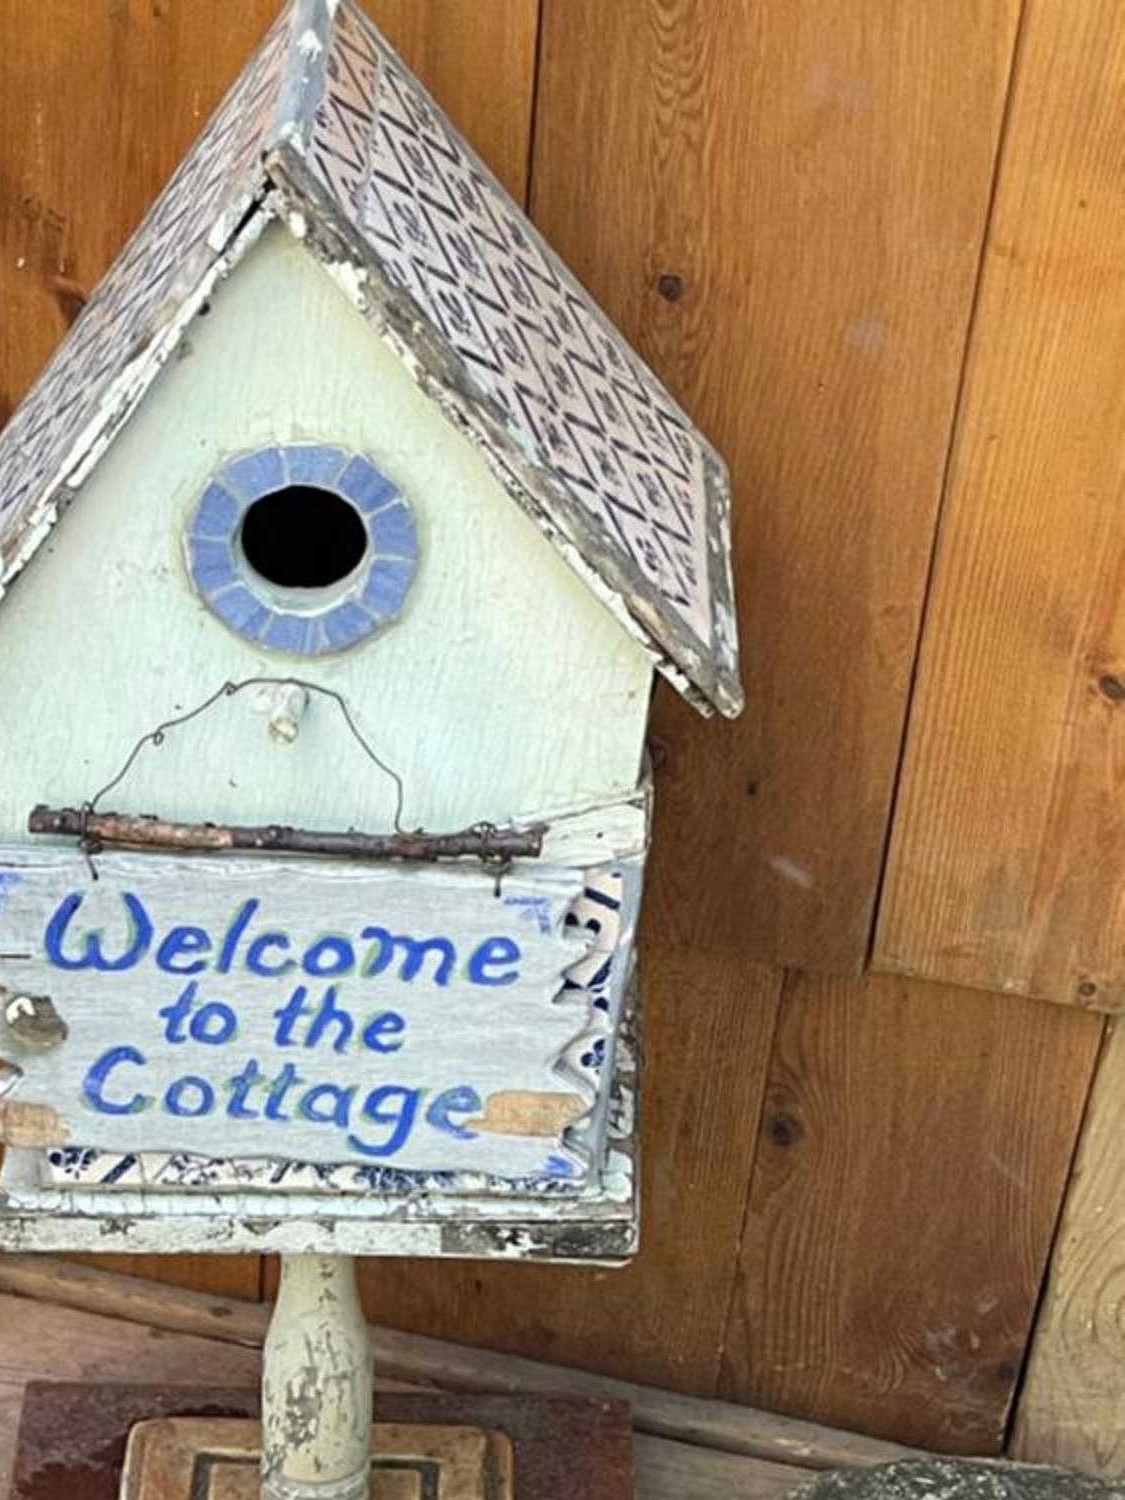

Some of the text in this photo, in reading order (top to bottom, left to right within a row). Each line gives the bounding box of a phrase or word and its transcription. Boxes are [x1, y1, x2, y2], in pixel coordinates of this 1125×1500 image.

[43, 891, 521, 987] Welcome
[158, 980, 407, 1054] to the
[82, 1045, 481, 1158] Cottage
